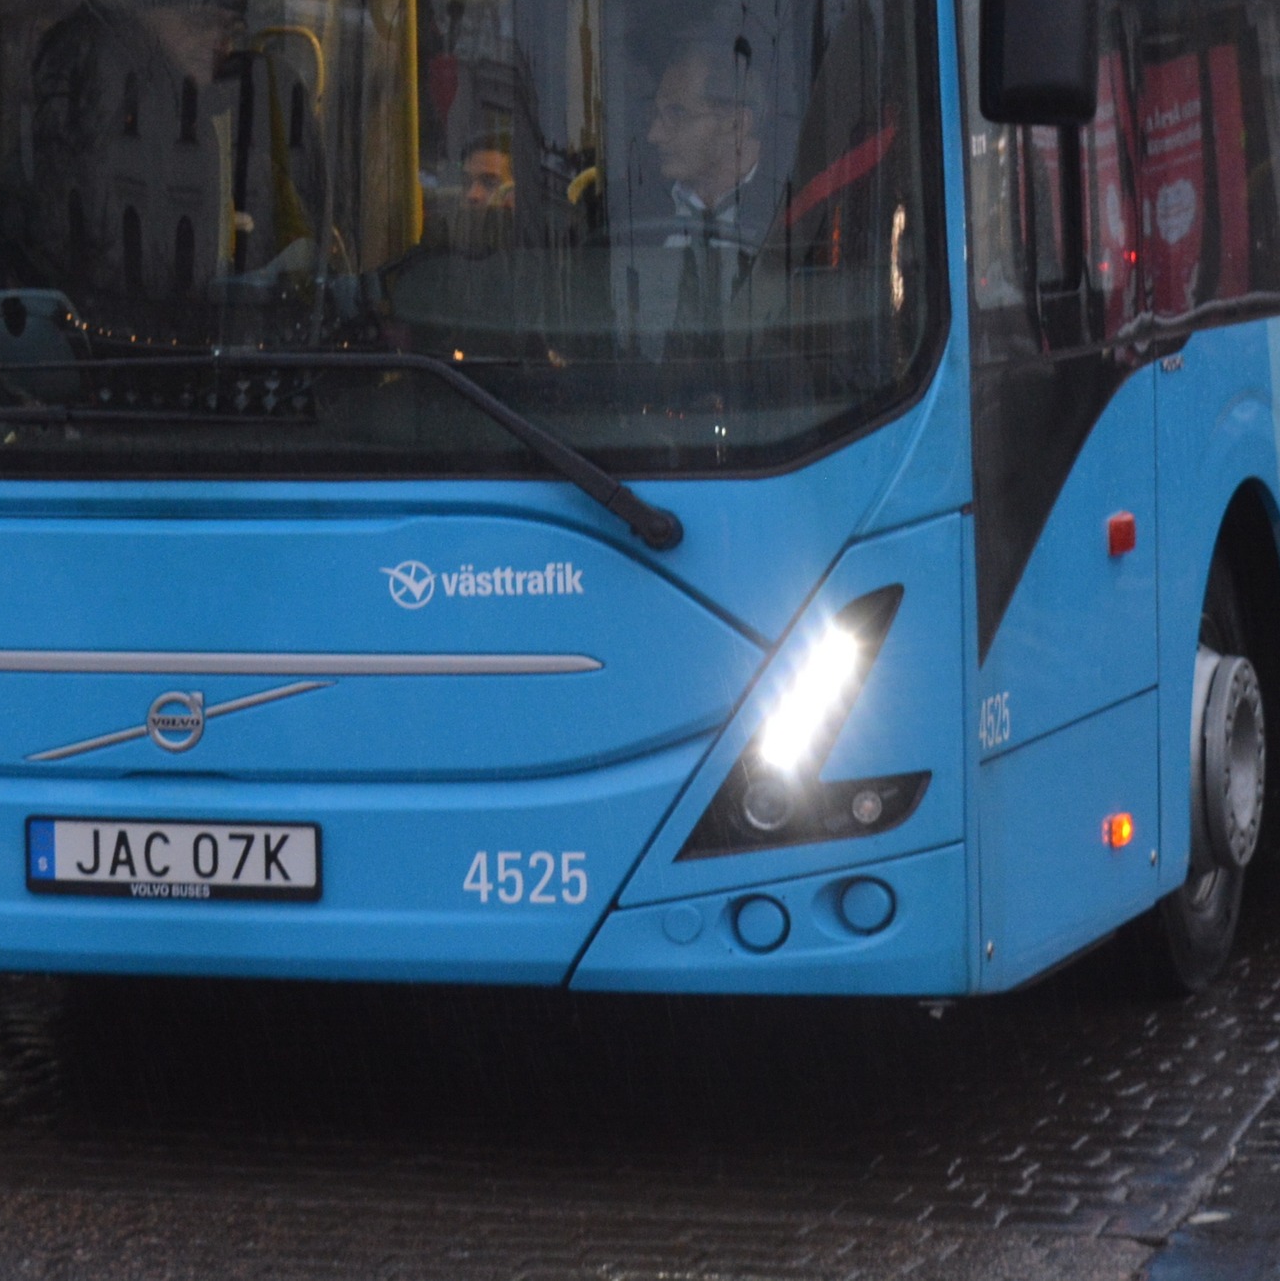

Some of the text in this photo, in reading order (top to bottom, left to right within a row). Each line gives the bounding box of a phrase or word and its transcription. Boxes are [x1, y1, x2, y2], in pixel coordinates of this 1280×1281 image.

[441, 562, 585, 597] västtrafik
[152, 717, 201, 727] VOLVO
[979, 691, 1010, 750] 4525
[76, 829, 292, 881] JAC 07K
[131, 883, 211, 898] VOLVO BUSES
[463, 850, 588, 904] 4525
